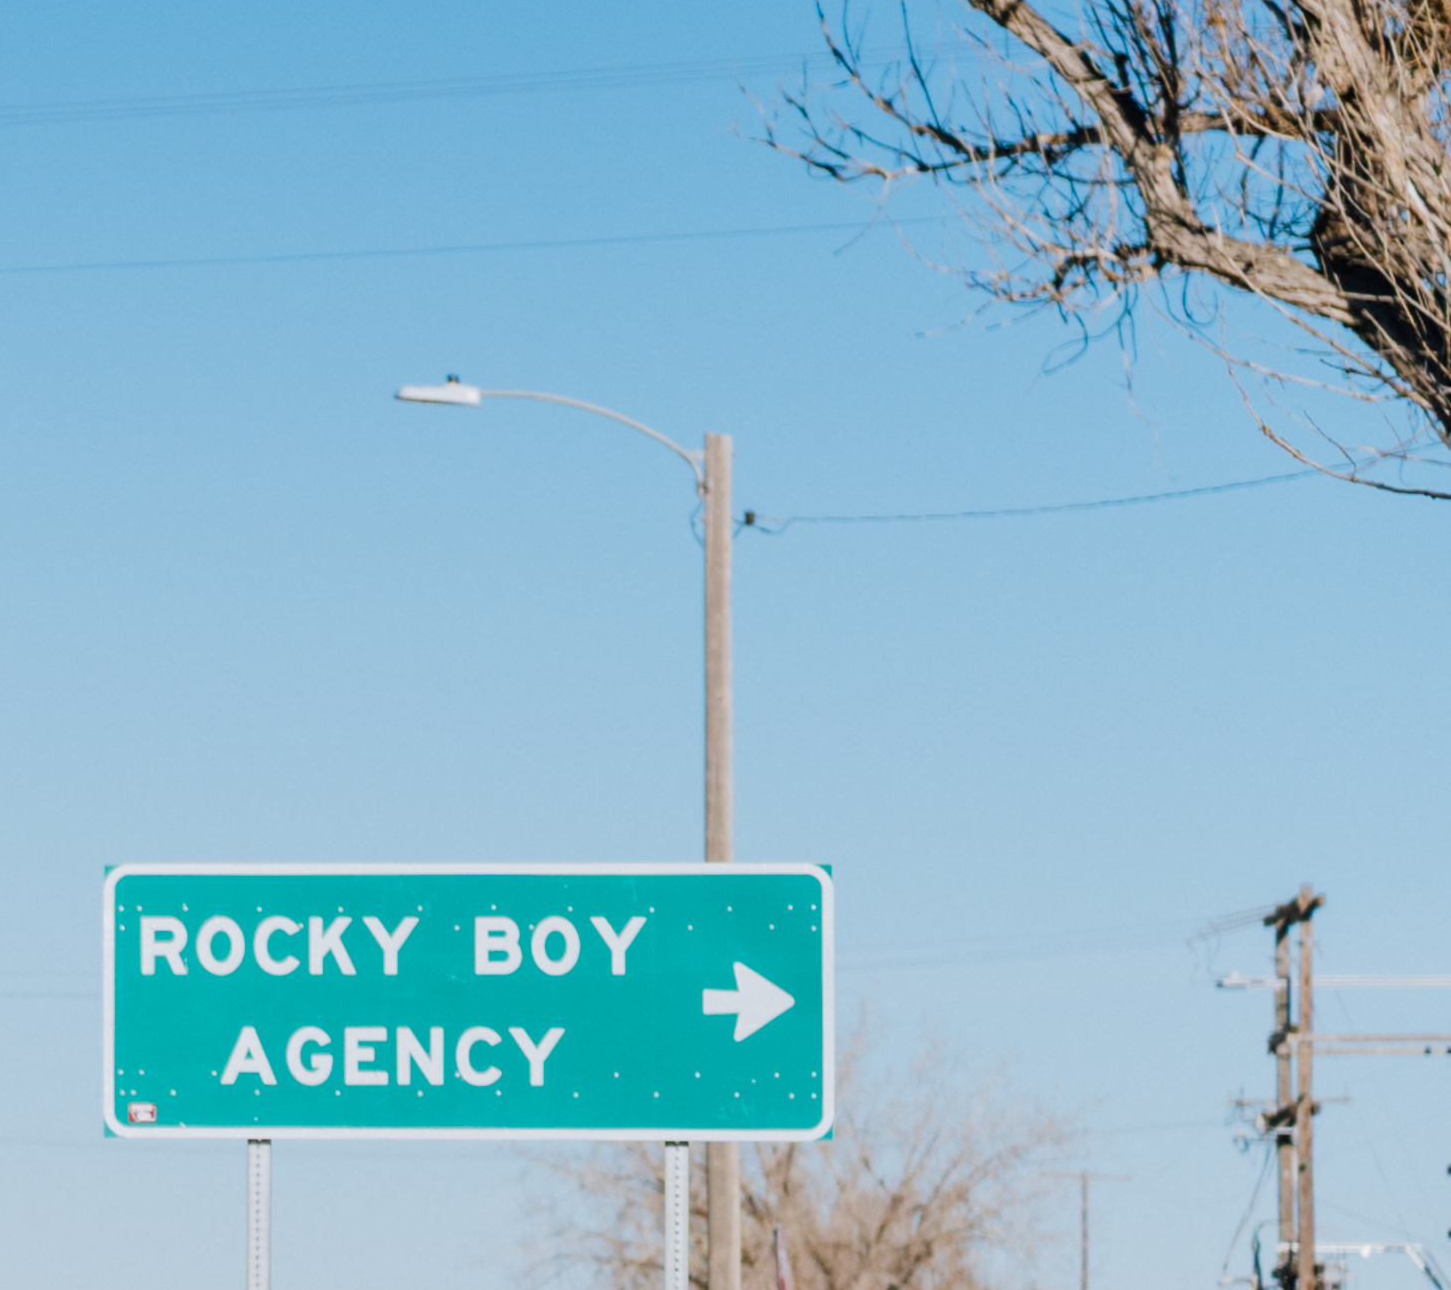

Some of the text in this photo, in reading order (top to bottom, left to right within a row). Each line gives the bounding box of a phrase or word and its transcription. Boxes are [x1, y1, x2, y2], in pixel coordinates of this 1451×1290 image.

[139, 916, 647, 976] ROCKY BOY
[220, 1026, 565, 1087] AGENCY
